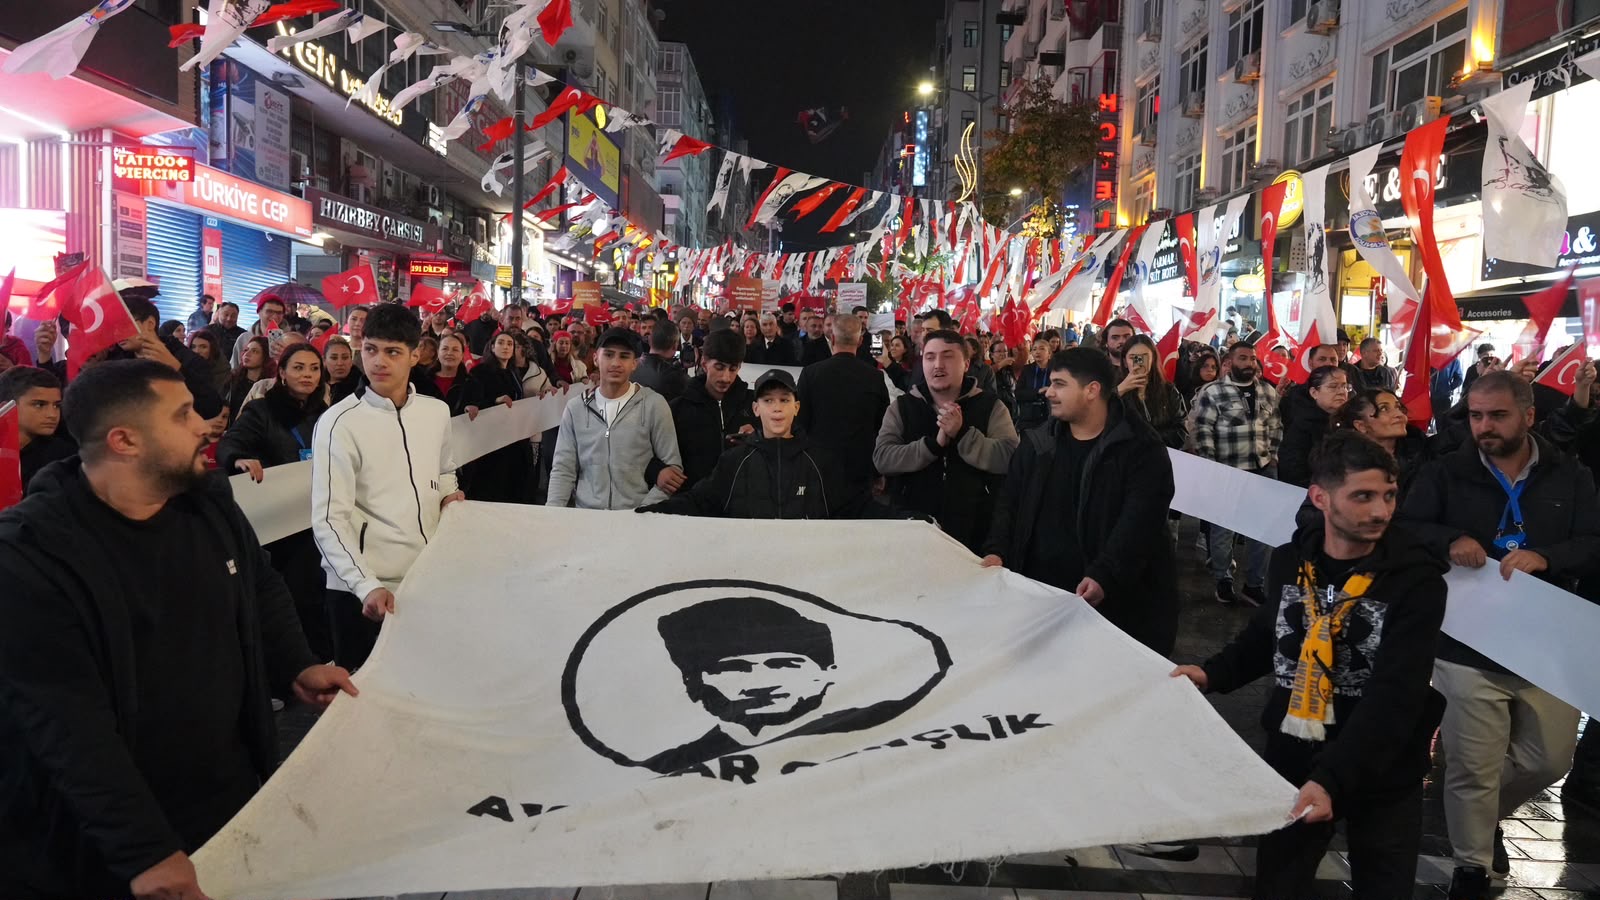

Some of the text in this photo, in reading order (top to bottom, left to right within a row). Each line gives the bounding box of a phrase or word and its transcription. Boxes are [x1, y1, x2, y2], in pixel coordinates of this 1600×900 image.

[118, 154, 176, 167] TATTOO
[118, 166, 190, 180] PIERCING
[193, 173, 288, 222] TÜRKİYE CEP
[320, 197, 381, 232] HIZIRBEY
[1467, 309, 1512, 318] Accessories
